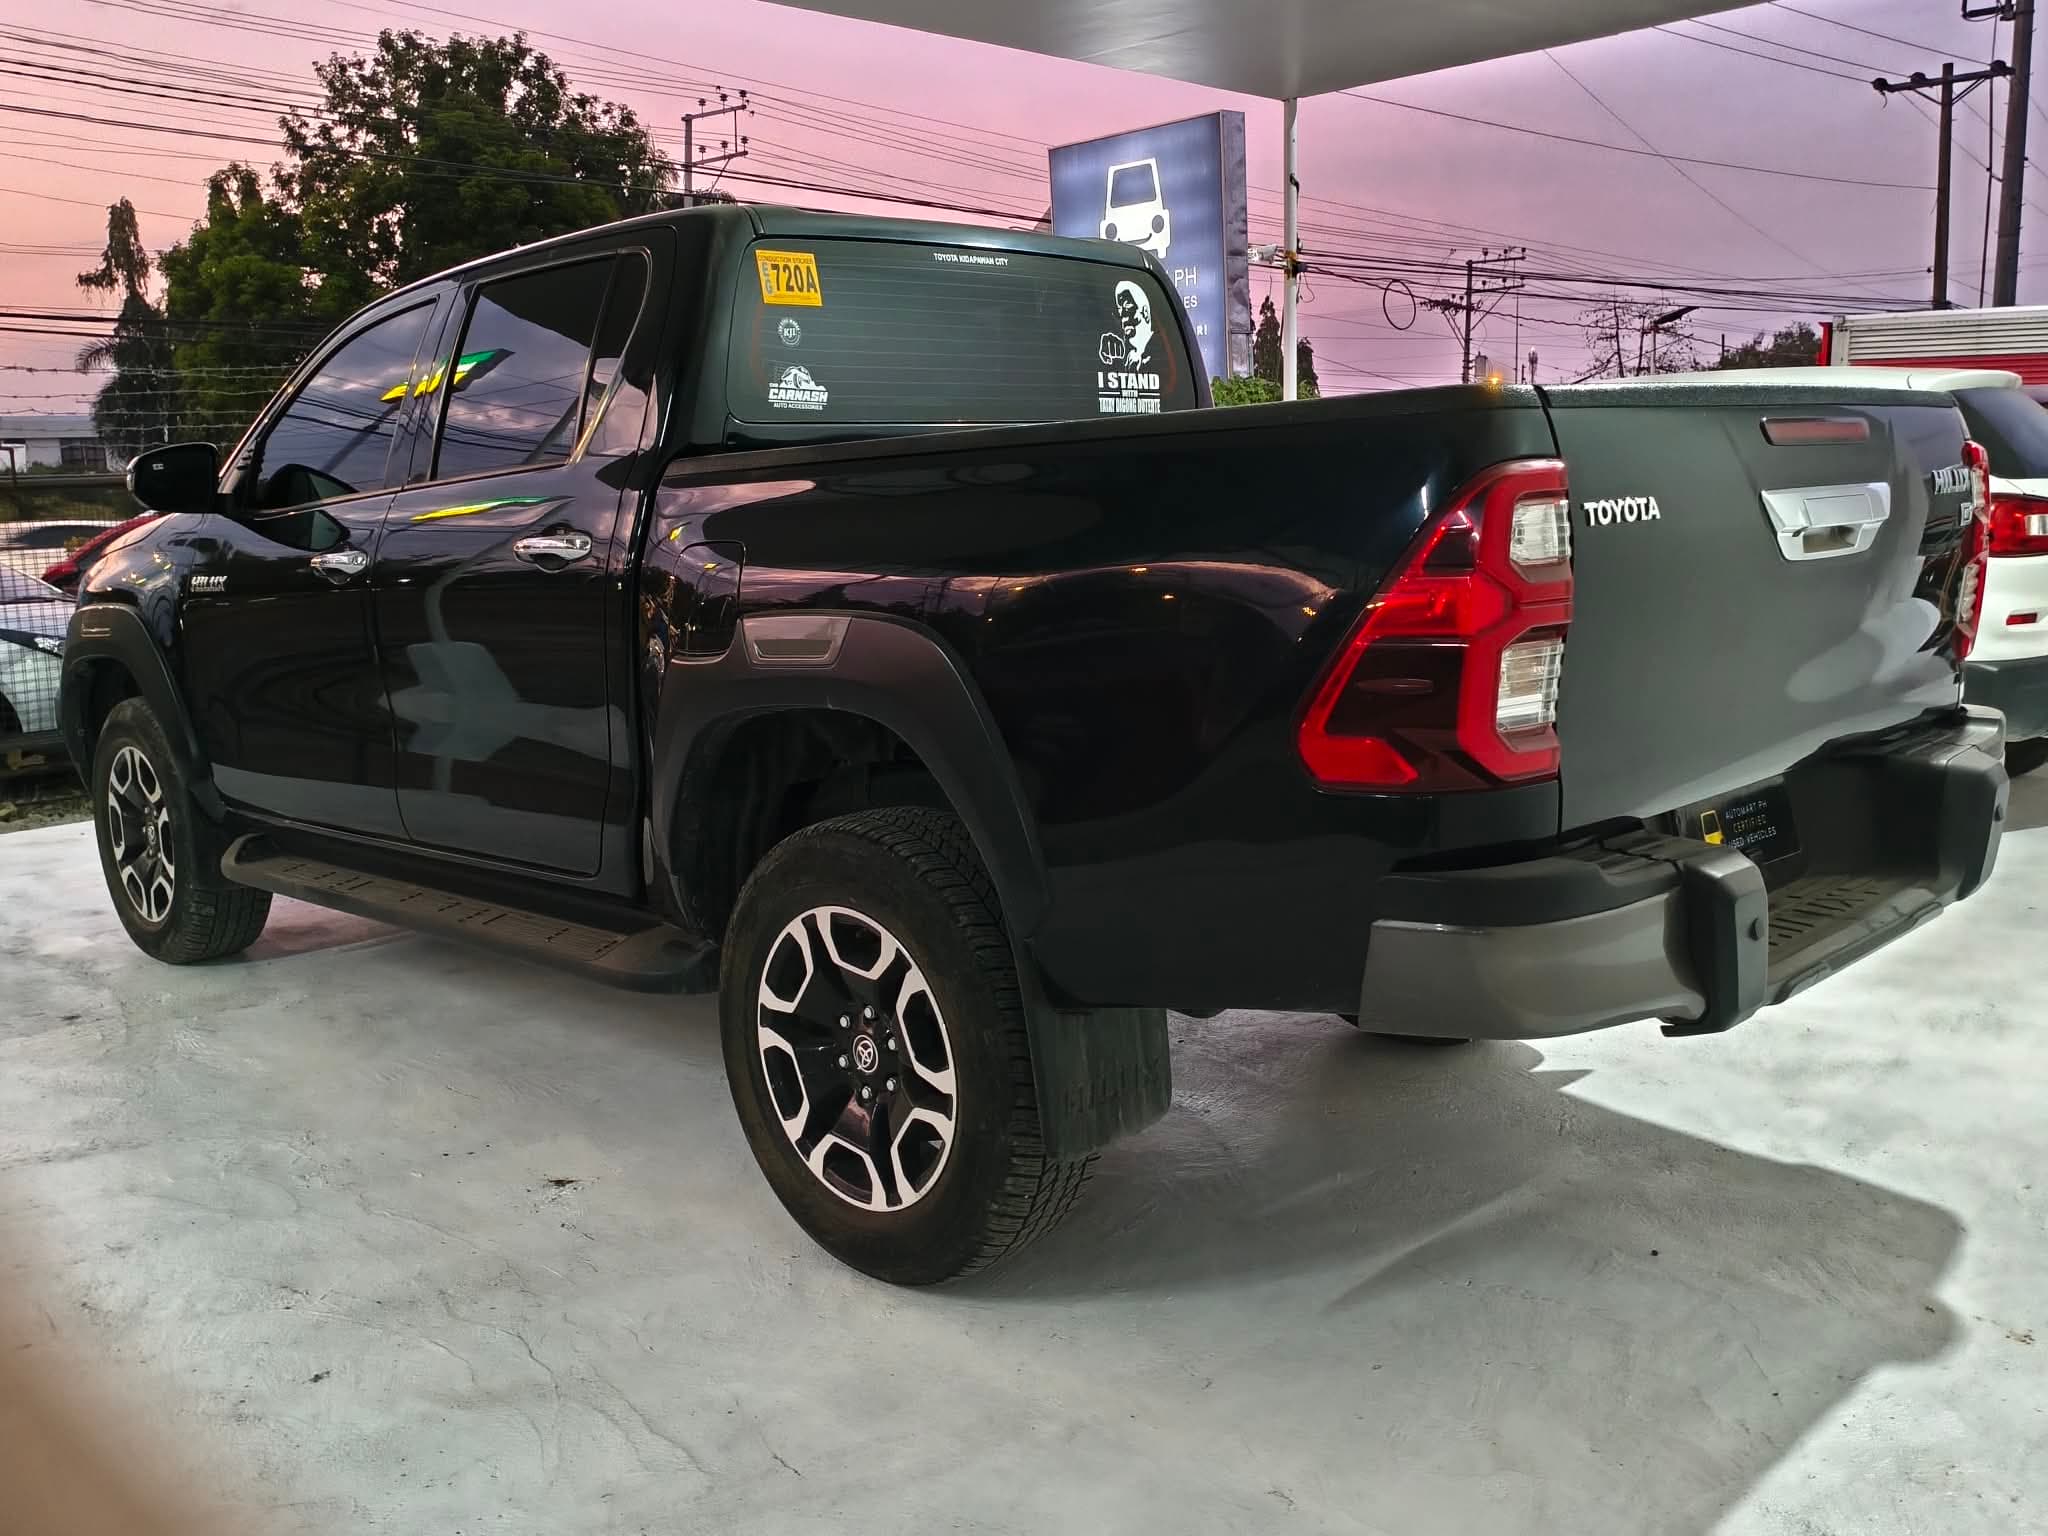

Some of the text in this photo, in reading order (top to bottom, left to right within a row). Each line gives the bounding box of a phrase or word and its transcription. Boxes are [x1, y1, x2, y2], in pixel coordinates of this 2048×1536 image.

[933, 252, 958, 263] TOYOTA
[995, 257, 1009, 266] CITY
[771, 263, 818, 293] 720A
[1097, 371, 1160, 389] I STAND
[1583, 496, 1661, 527] TOYOTA
[1726, 802, 1757, 819] AUTOMART
[1733, 814, 1767, 833] CERTIFIED
[1746, 826, 1777, 844] VEHICLES
